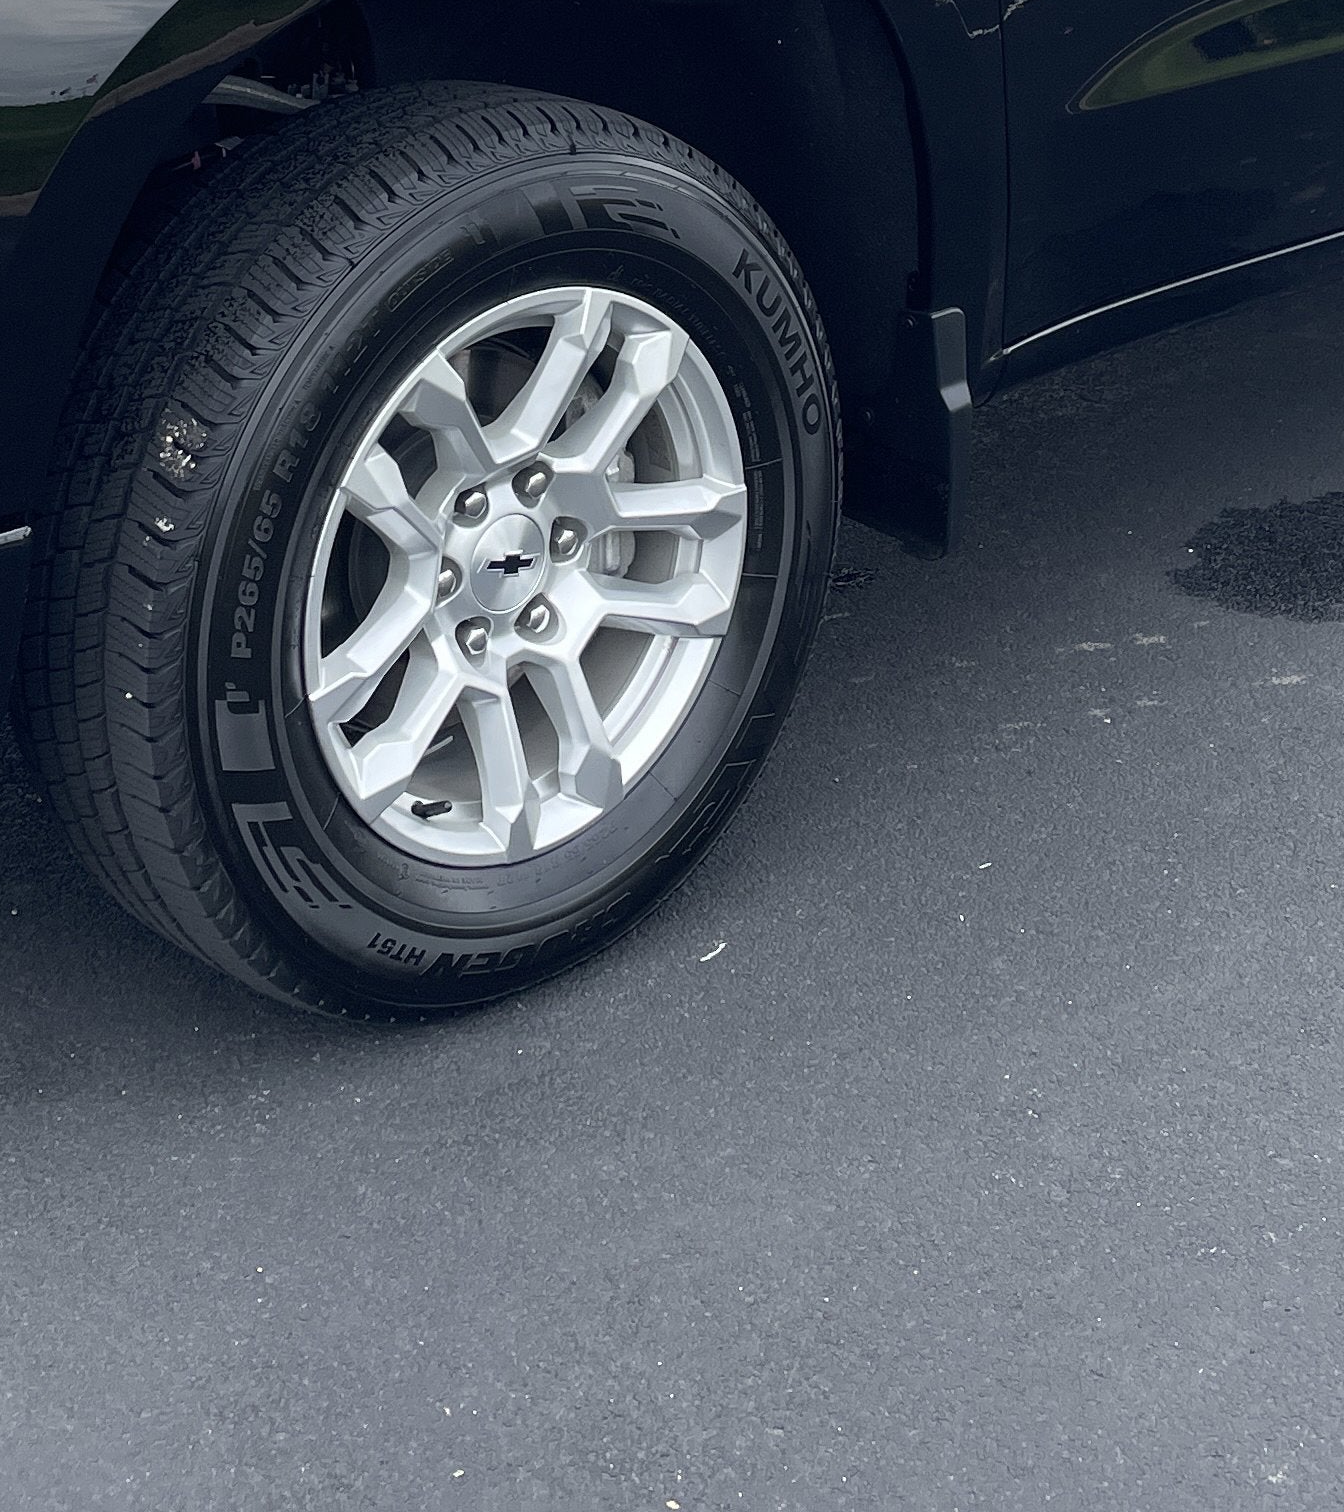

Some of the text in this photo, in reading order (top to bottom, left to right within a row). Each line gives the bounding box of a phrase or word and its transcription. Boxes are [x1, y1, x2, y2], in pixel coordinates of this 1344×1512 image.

[731, 247, 822, 436] KUMHO
[231, 489, 282, 658] P265/65
[366, 931, 426, 966] HT51
